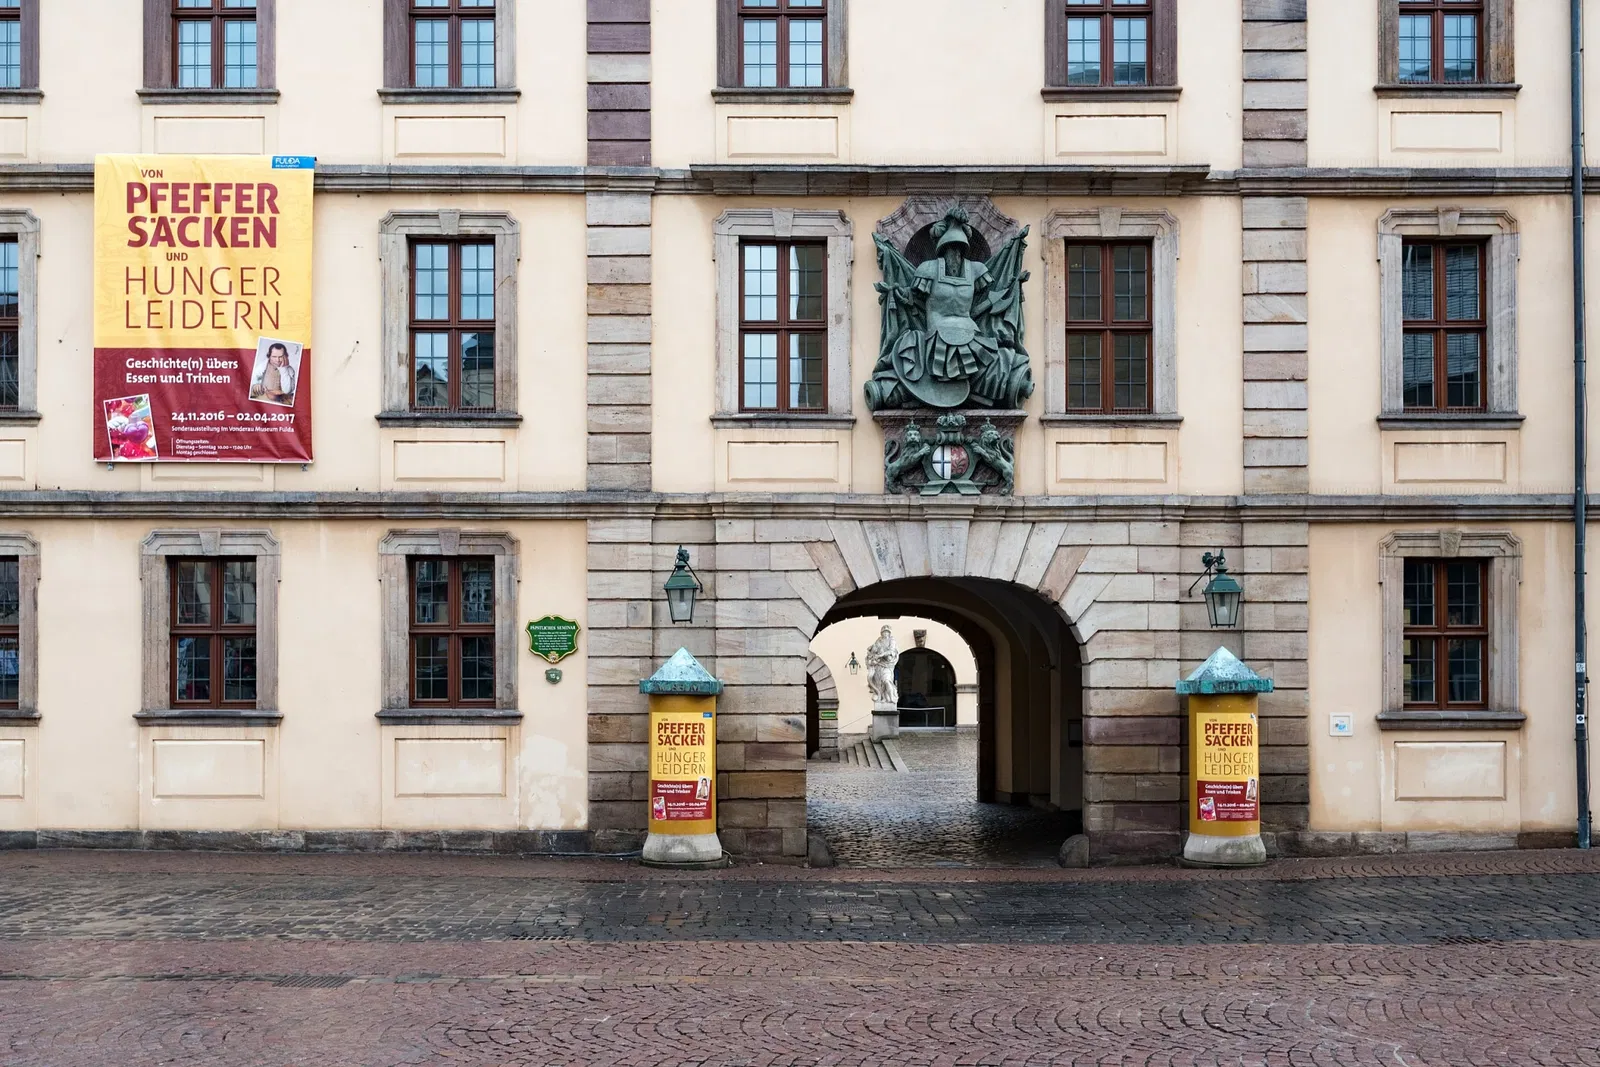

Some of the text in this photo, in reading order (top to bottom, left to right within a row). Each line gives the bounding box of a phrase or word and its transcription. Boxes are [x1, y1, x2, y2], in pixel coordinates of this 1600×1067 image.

[275, 157, 300, 165] FULDA
[141, 169, 163, 178] VON
[126, 182, 280, 214] PFEFFER
[127, 216, 277, 248] SÄCKEN
[166, 252, 188, 261] UND
[126, 266, 281, 296] HUNGER
[126, 300, 279, 330] LEIDERN
[126, 358, 238, 371] Geschichte(n) übers
[126, 373, 230, 383] Essen und Trinken
[171, 410, 224, 422] 24.11.2016
[236, 413, 295, 424] 02.04.2017
[171, 425, 220, 434] Sonderausstellung
[657, 722, 705, 734] PFEFFER
[1204, 723, 1253, 735] PFEFFER
[657, 734, 705, 746] SÄCKEN
[1205, 735, 1253, 747] SÄCKEN
[656, 752, 706, 763] HUNGER
[1204, 752, 1254, 763] HUNGER
[656, 763, 706, 774] LEIDERN
[1204, 764, 1254, 775] LEIDERN
